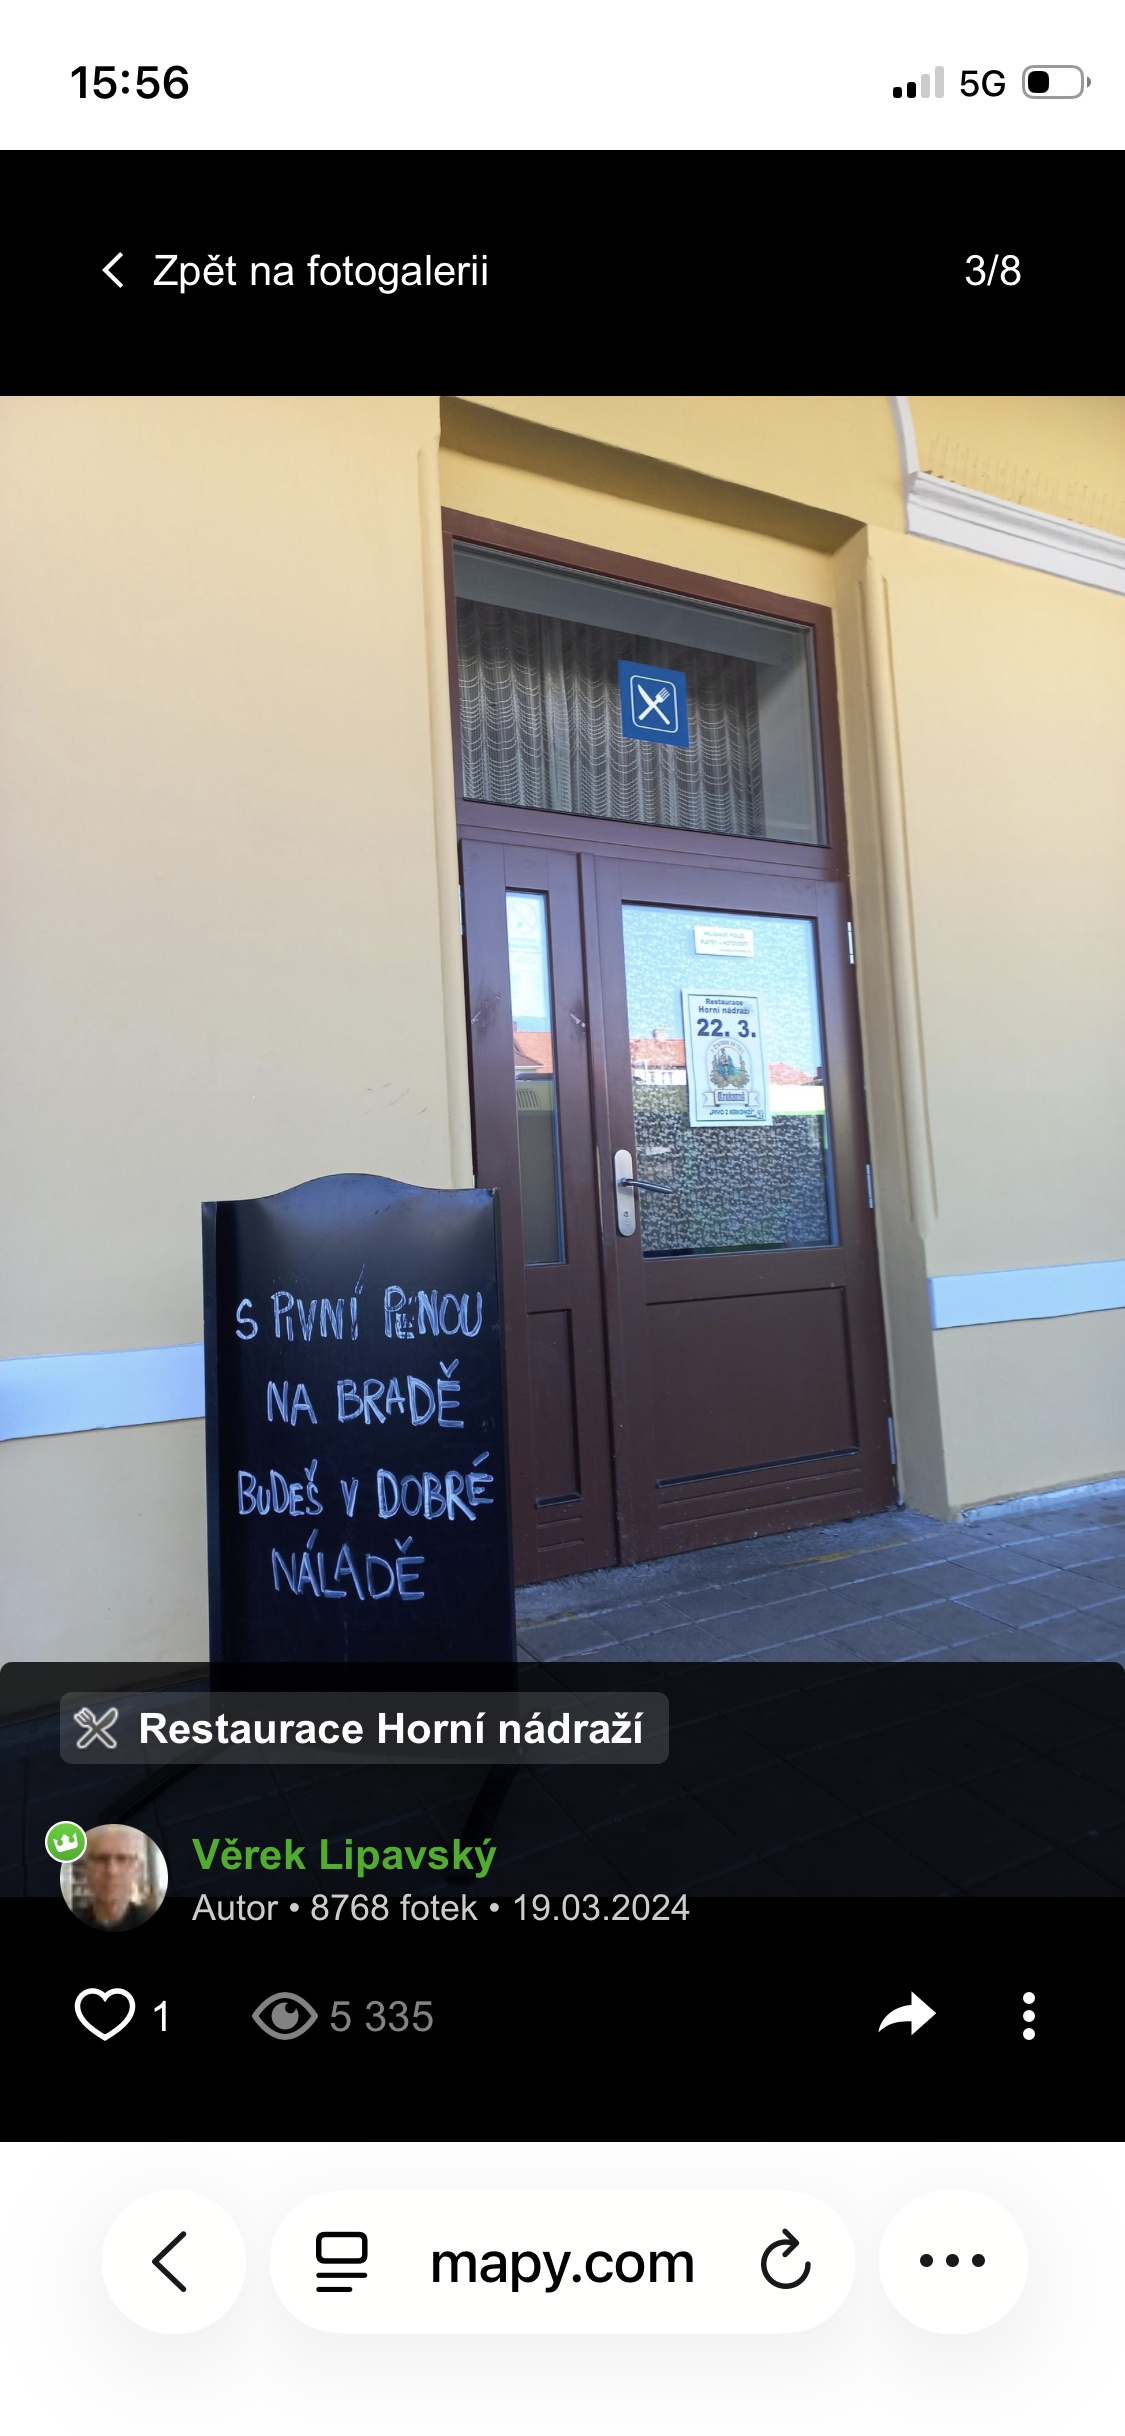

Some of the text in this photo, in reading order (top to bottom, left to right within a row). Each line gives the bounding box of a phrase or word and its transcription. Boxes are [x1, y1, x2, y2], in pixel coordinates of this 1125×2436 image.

[697, 1018, 757, 1038] 22. 3.
[235, 1297, 259, 1341] S
[267, 1358, 464, 1428] NA BRADĚ
[377, 1451, 494, 1520] DOBRÉ
[272, 1528, 425, 1600] NÁLADĚ
